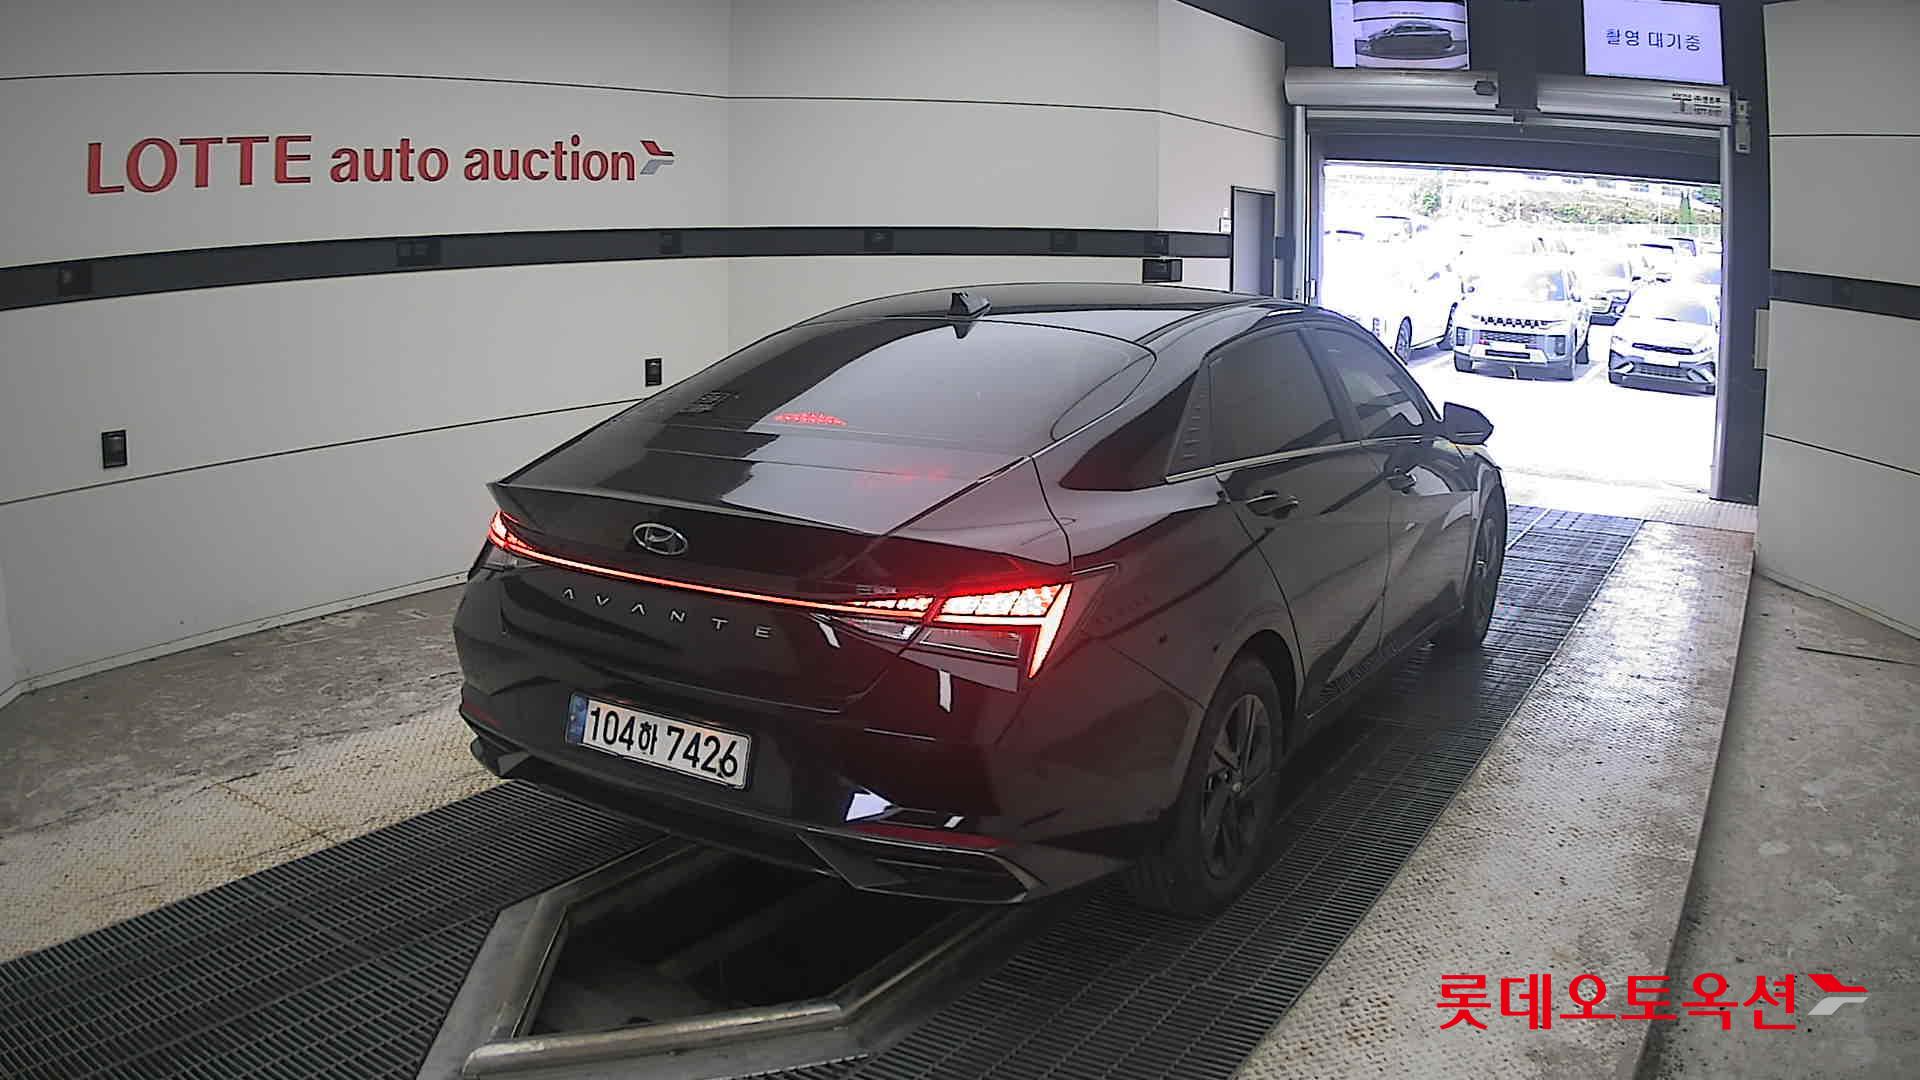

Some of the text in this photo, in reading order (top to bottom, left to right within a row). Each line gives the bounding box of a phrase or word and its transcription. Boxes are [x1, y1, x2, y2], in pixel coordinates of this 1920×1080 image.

[1647, 31, 1701, 52] 대기중
[87, 134, 637, 194] LOTTE auto auction
[562, 588, 772, 638] AVANTE
[590, 705, 739, 779] 104하 7426
